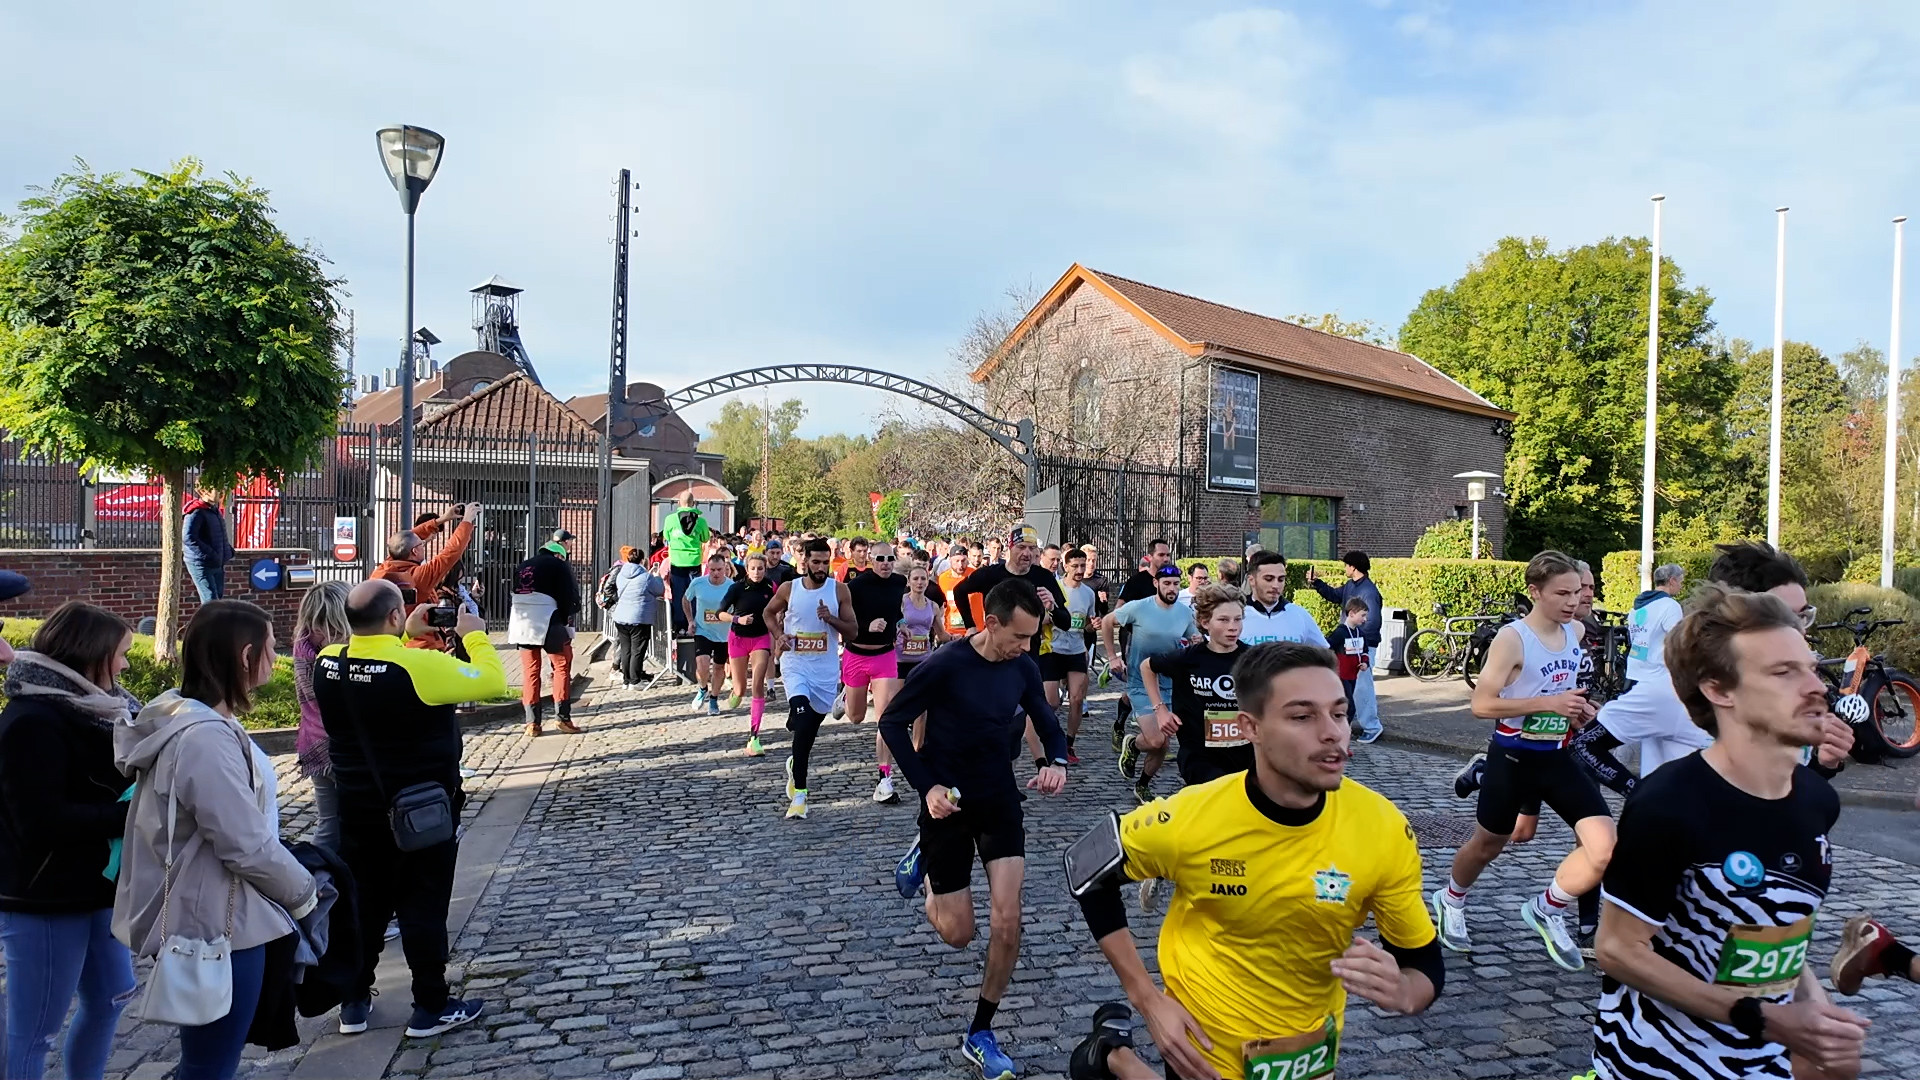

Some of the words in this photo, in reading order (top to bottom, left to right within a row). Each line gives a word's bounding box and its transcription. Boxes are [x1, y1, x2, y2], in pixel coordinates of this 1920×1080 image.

[797, 639, 824, 649] 5278
[906, 641, 925, 650] 5341
[349, 664, 388, 674] MY-CARS
[1540, 659, 1578, 677] RCABW
[1551, 672, 1569, 683] 1957
[1205, 701, 1227, 709] running
[1529, 717, 1567, 731] 2755
[1212, 723, 1243, 738] 516
[1211, 866, 1246, 877] SPORT
[1210, 883, 1248, 896] JAKO
[1731, 940, 1809, 978] 2973
[1253, 1045, 1329, 1080] 2782
